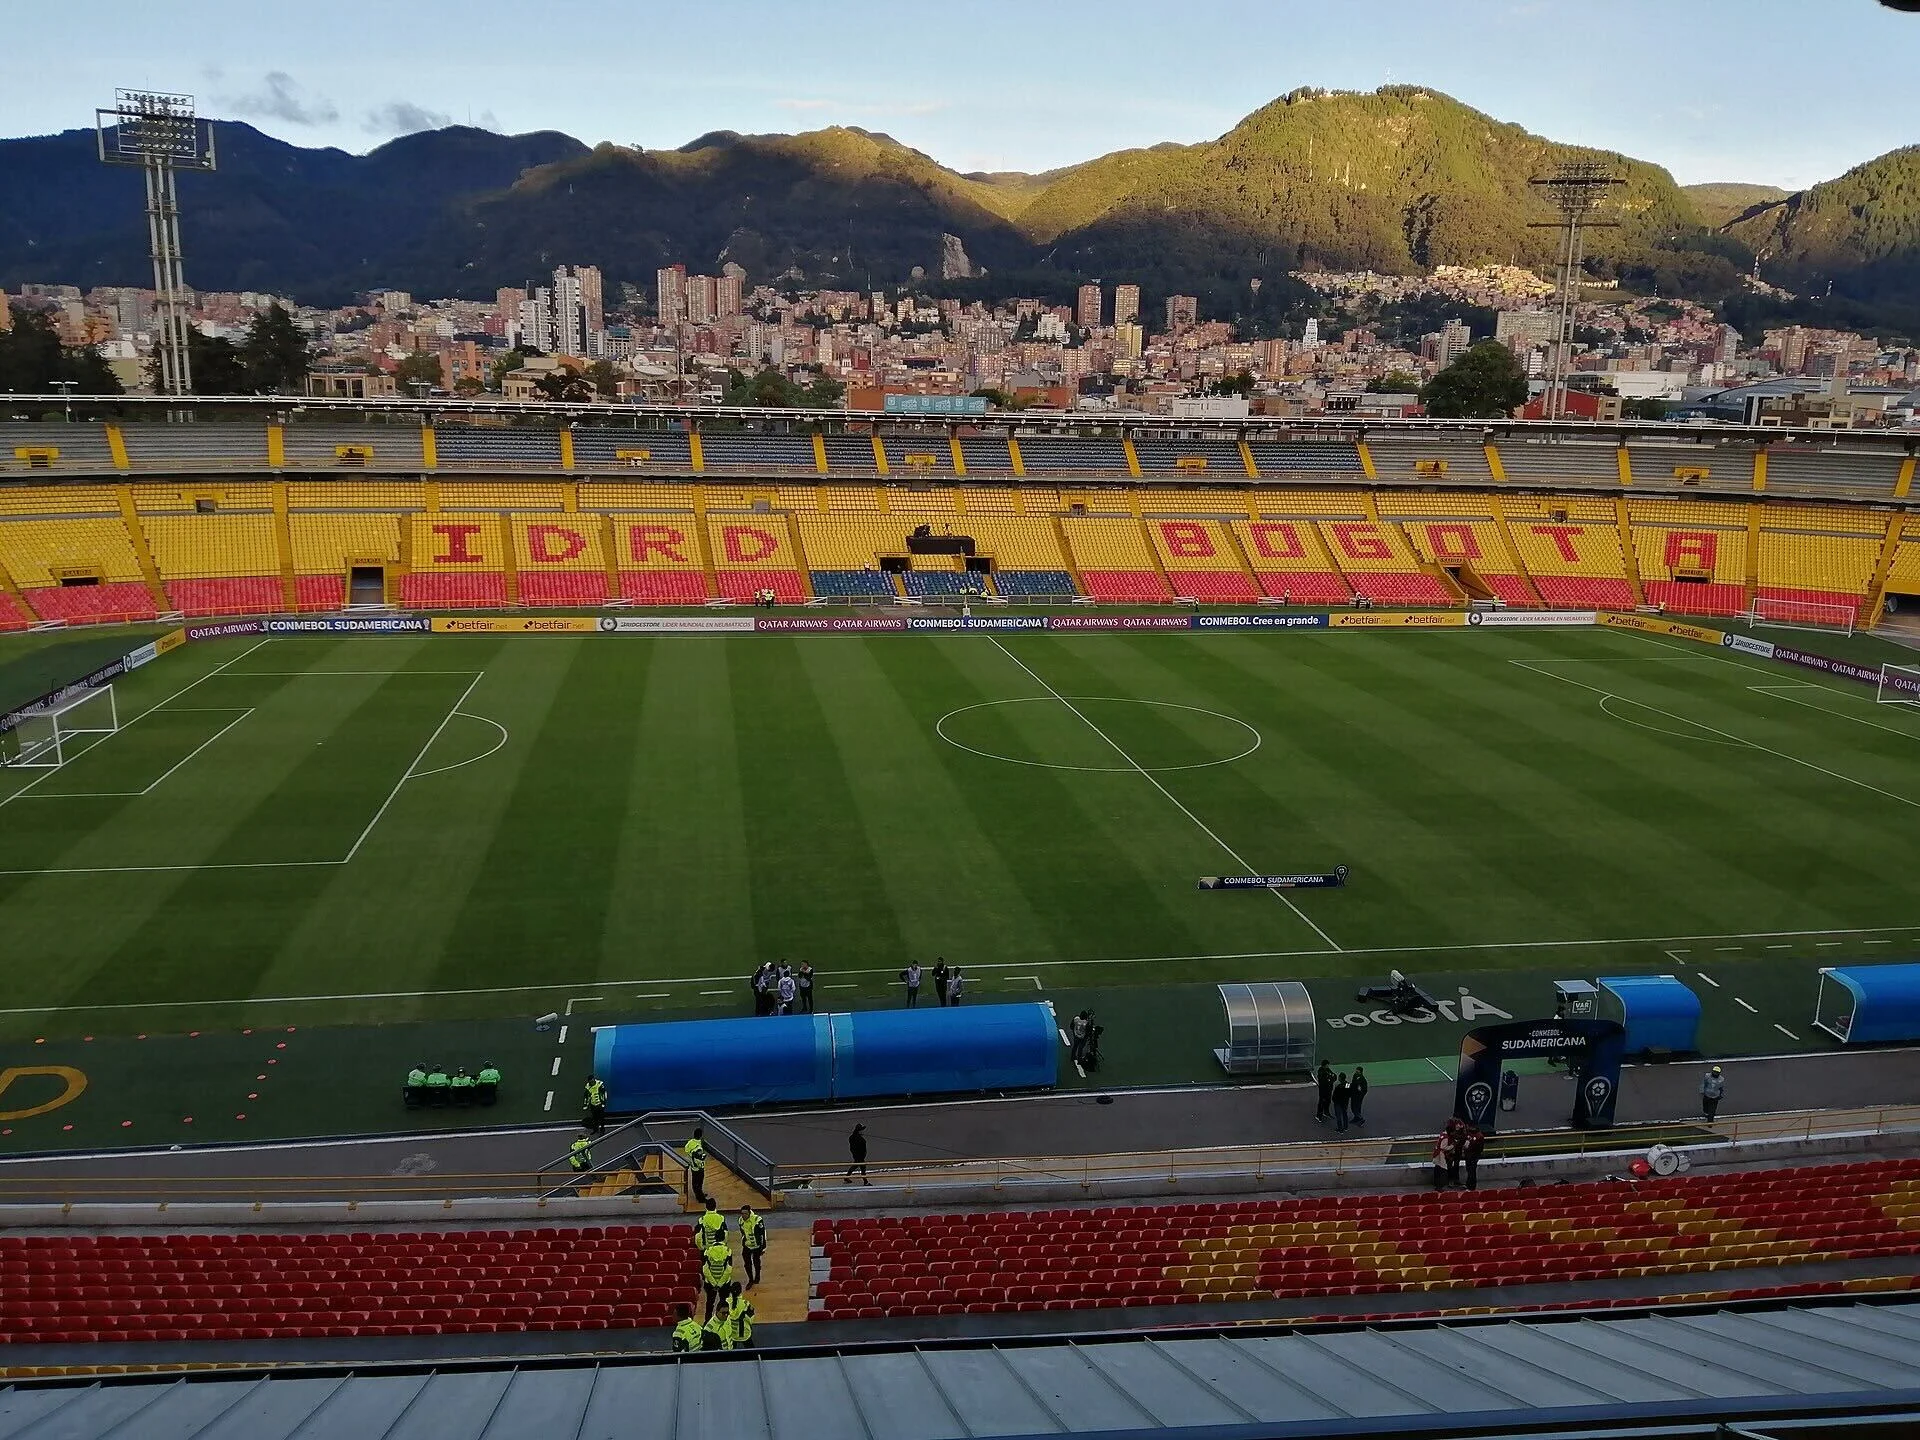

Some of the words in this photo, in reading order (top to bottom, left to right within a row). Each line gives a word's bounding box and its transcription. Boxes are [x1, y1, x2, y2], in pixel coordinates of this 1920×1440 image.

[433, 525, 778, 563] IDRD
[270, 621, 334, 631] CONMEBOL
[335, 619, 423, 631] SUDAMERICANA
[759, 620, 789, 630] QATAR
[790, 620, 828, 628] AIRWAYS
[833, 619, 863, 629] QATAR
[864, 619, 901, 628] AIRWAYS
[913, 619, 966, 628] CONMEBOL
[967, 619, 1042, 628] SUDAMERICANA
[1053, 618, 1082, 628] QATAR
[1082, 618, 1119, 627] AIRWAYS
[1123, 618, 1151, 628] QATAR
[1152, 618, 1188, 626] AIRWAYS
[1200, 616, 1251, 626] CONMEBOL
[1252, 616, 1274, 625] Cree
[190, 627, 221, 639] QATAR
[222, 622, 258, 634] AIRWAYS
[1775, 648, 1799, 661] QATAR
[1799, 654, 1829, 669] AIRWAYS
[1831, 662, 1856, 676] QATAR
[1267, 876, 1324, 884] SUDAMERICANA
[1501, 1036, 1586, 1050] SUDAMERICANA
